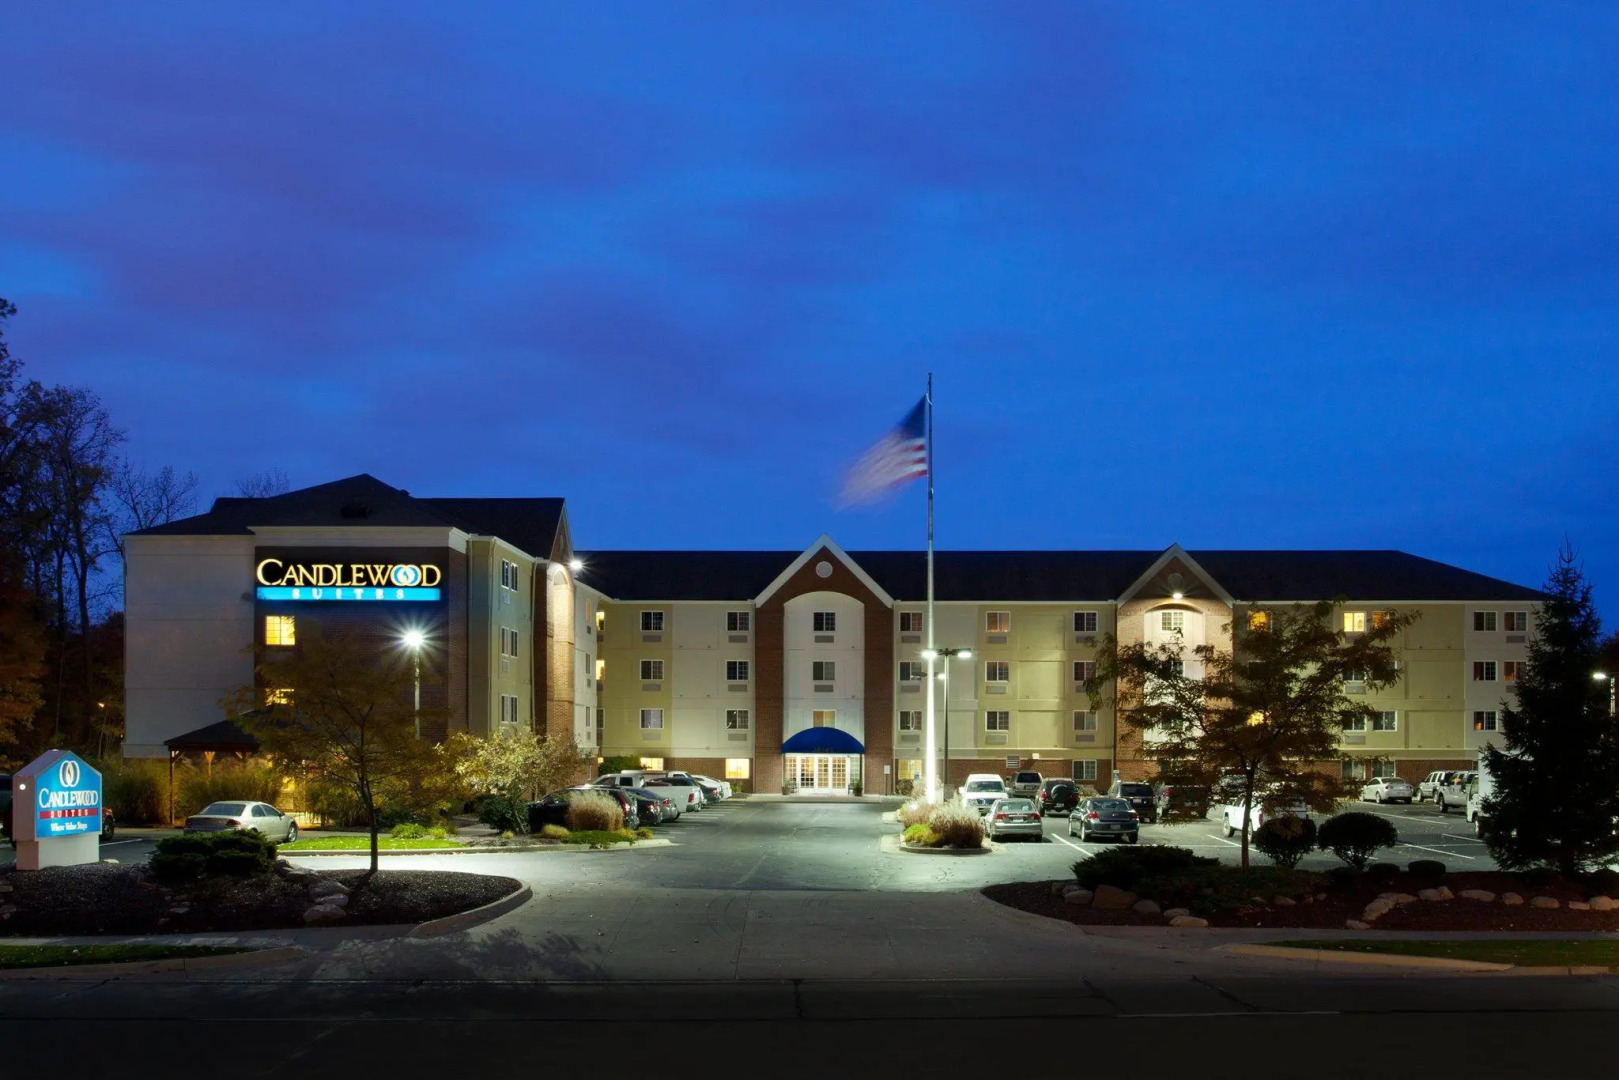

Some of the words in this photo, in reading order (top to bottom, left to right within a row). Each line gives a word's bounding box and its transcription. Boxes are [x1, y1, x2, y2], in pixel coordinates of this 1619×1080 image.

[257, 558, 441, 587] CANDLEWOOD
[292, 588, 404, 600] SUITES
[39, 788, 98, 808] CANDLEWOOD
[50, 809, 88, 818] SUITES
